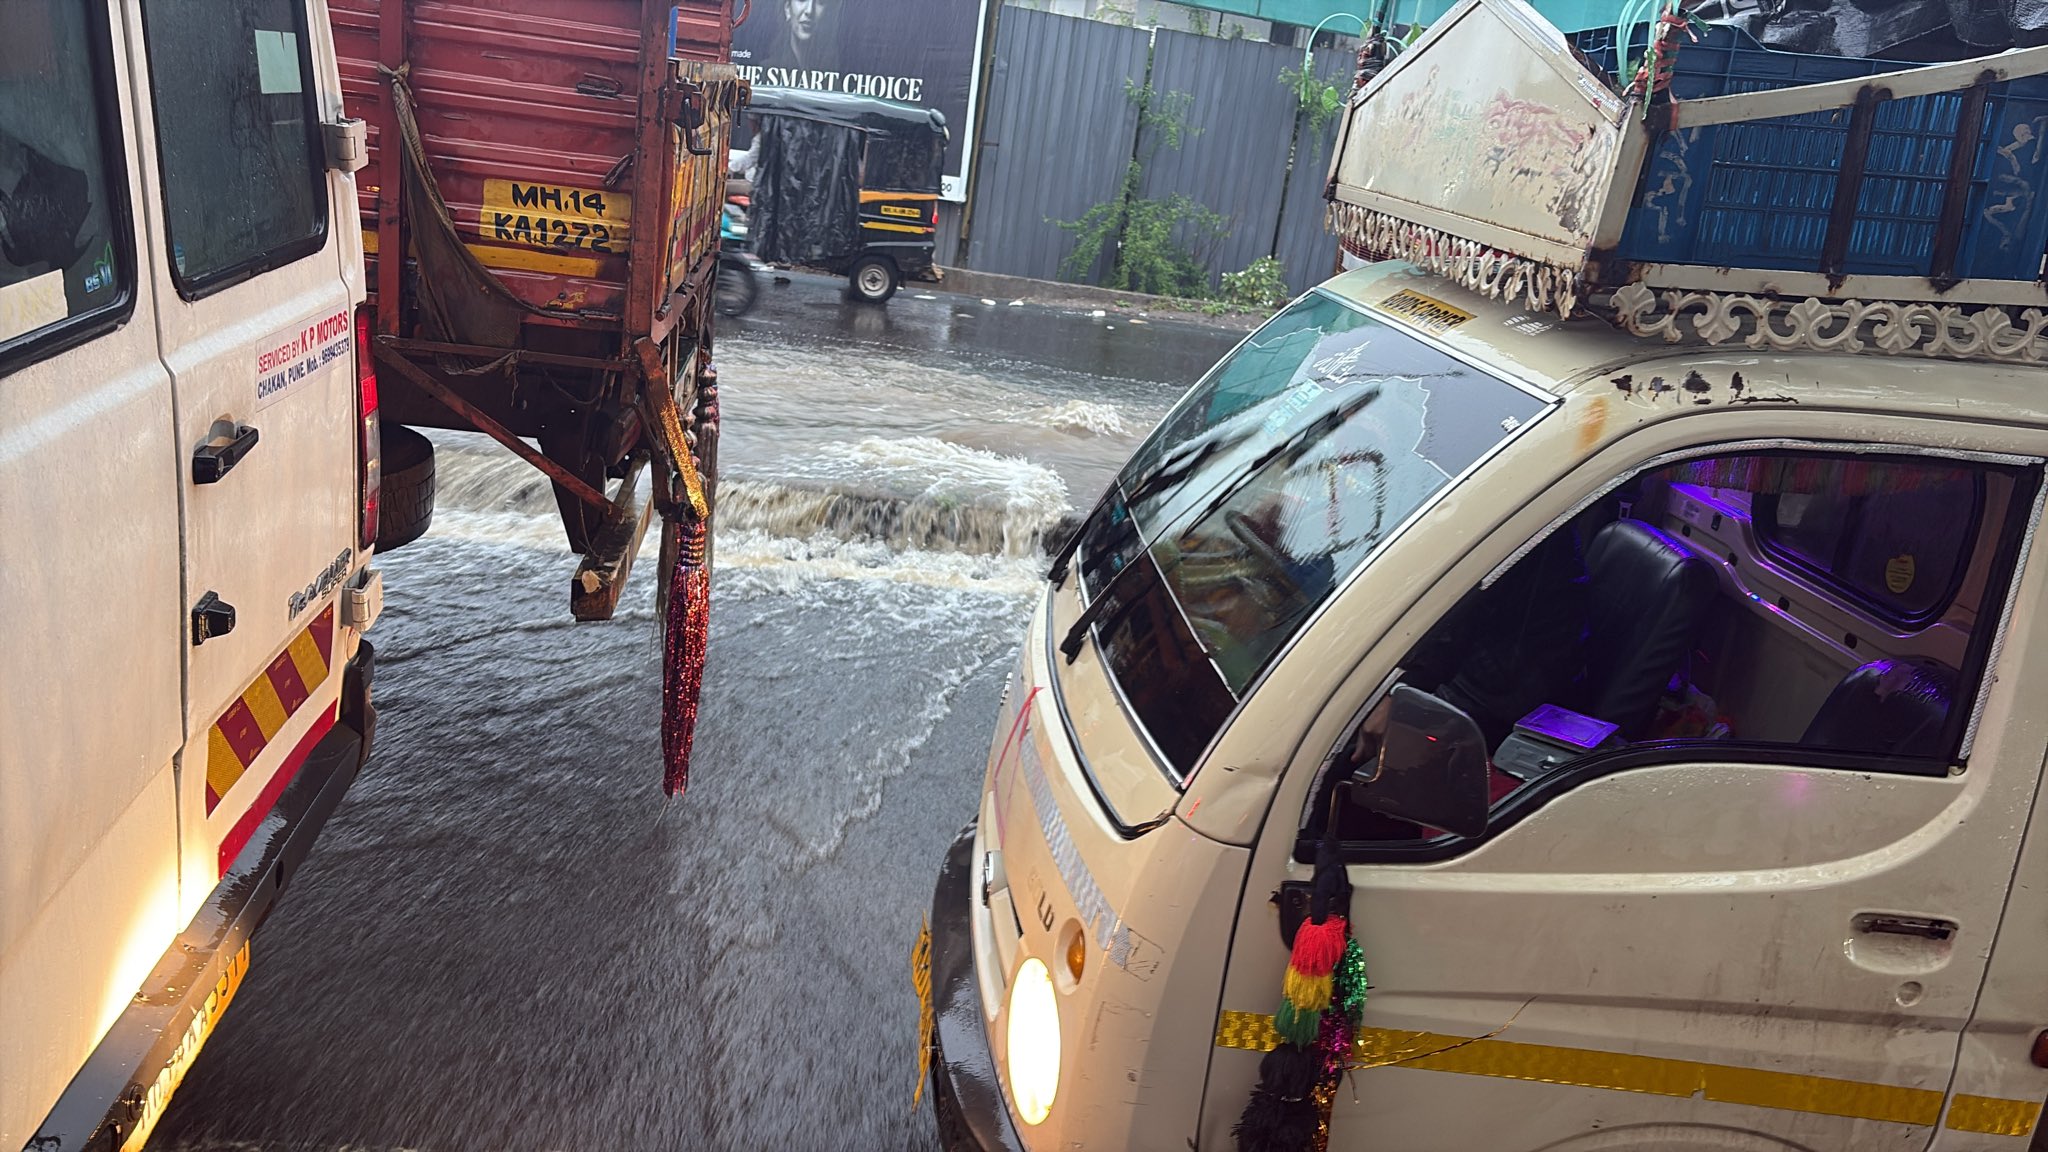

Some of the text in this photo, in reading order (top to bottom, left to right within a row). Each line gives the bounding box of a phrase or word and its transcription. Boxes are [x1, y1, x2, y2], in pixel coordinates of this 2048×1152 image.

[731, 50, 751, 59] made
[766, 67, 839, 91] SMART
[842, 73, 923, 102] CHOICE
[258, 310, 348, 374] SERVICED BY K P MOTORS
[257, 371, 287, 399] CHAKAN,
[321, 568, 347, 600] SUPER
